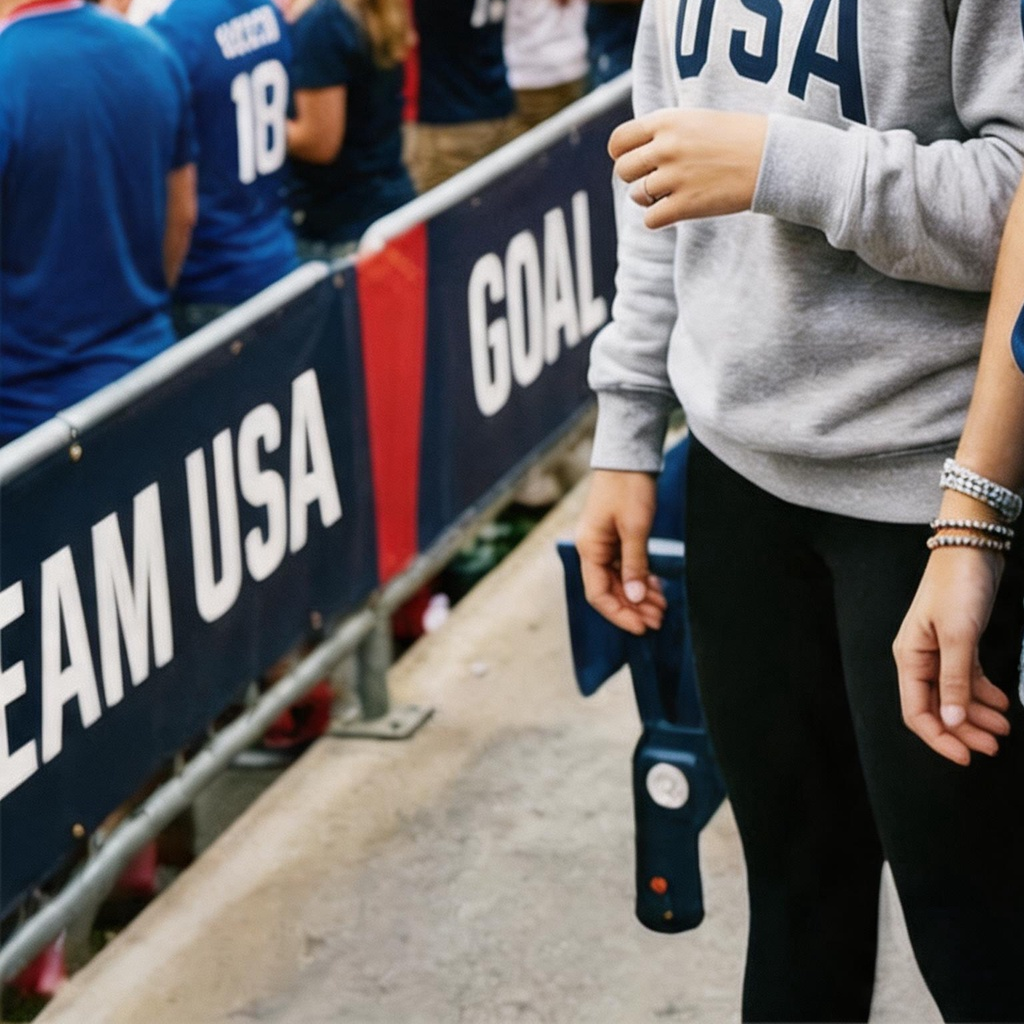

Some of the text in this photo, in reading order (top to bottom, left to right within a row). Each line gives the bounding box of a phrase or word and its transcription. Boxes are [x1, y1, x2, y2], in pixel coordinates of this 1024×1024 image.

[231, 59, 289, 184] 18
[467, 191, 607, 416] GOAL
[185, 369, 343, 622] USA
